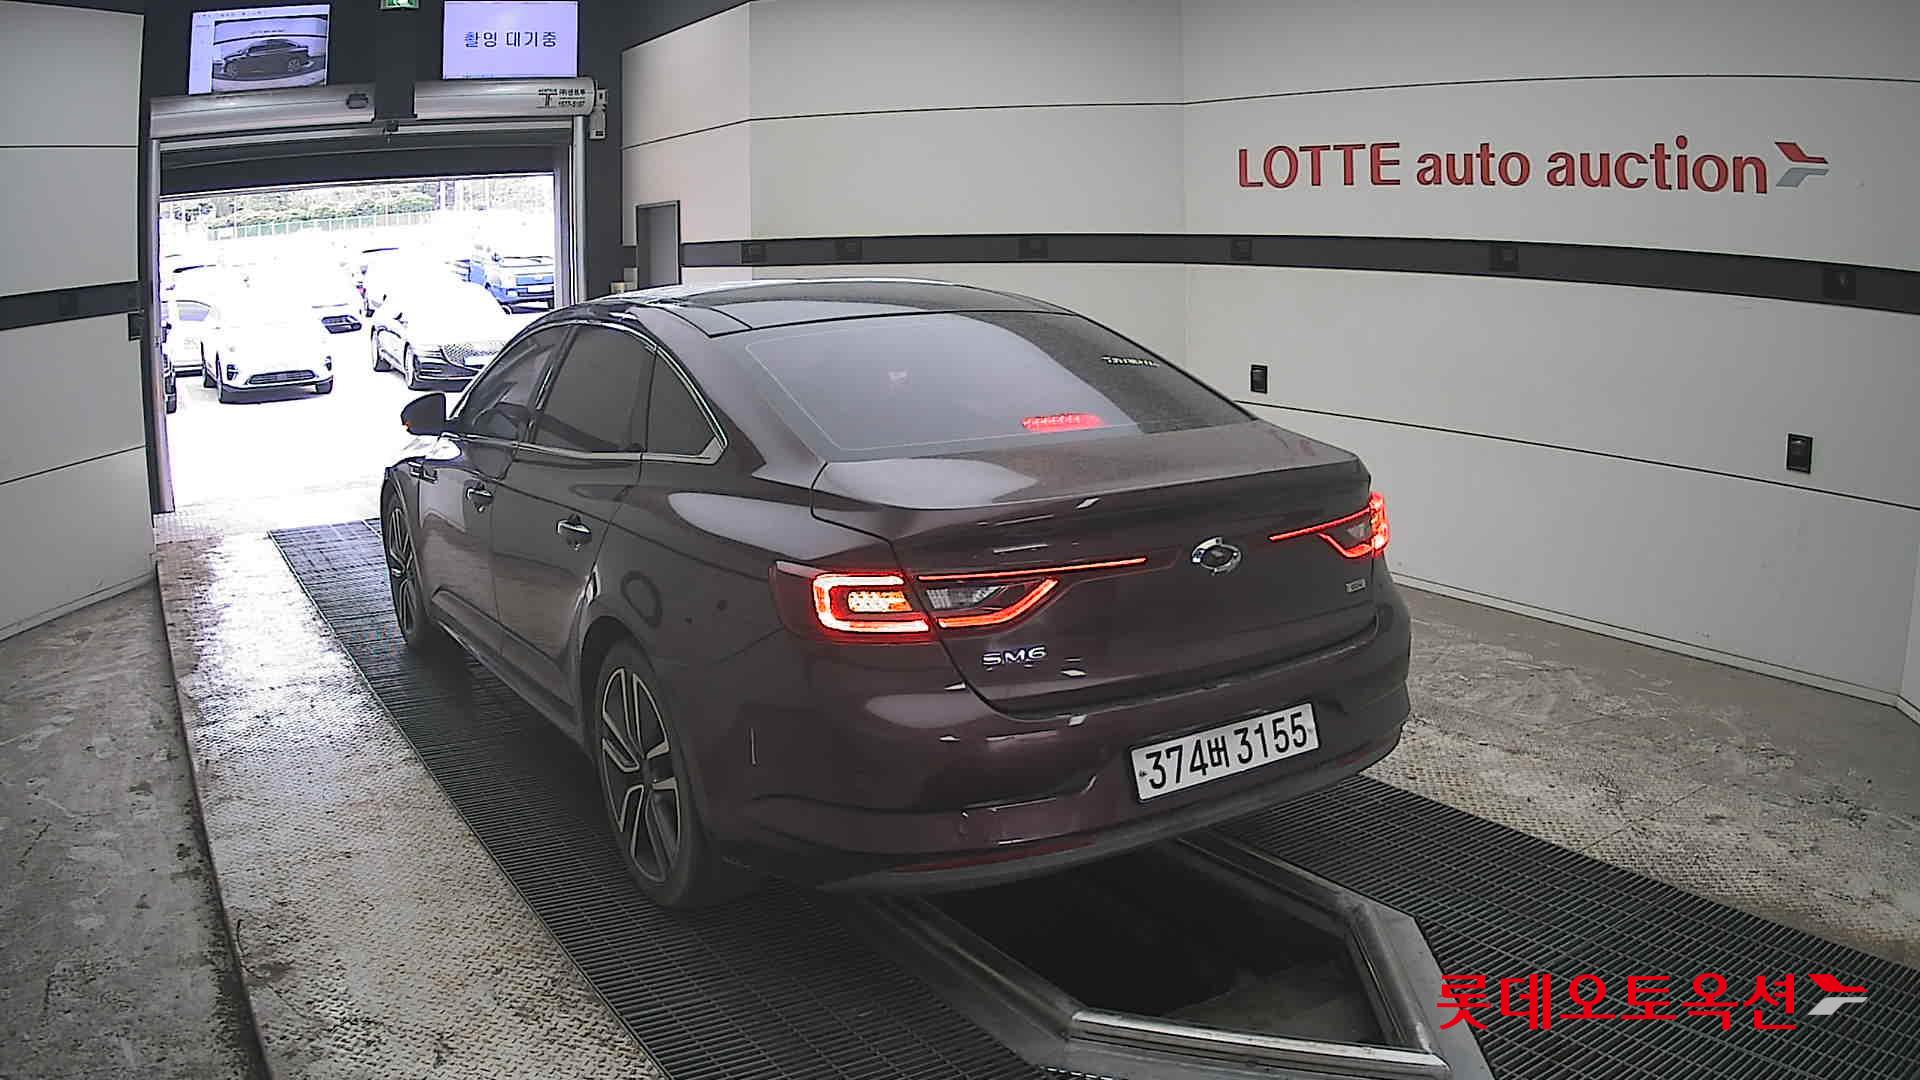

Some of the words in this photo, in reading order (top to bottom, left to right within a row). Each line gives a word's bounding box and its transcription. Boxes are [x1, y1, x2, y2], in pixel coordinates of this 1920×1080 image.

[506, 31, 557, 48] 대기중
[1238, 142, 1401, 189] LOTTE
[1416, 142, 1531, 187] auto
[1546, 135, 1768, 194] auction
[983, 646, 1047, 665] SM6
[1145, 735, 1230, 789] 374버
[1233, 712, 1307, 764] 3155
